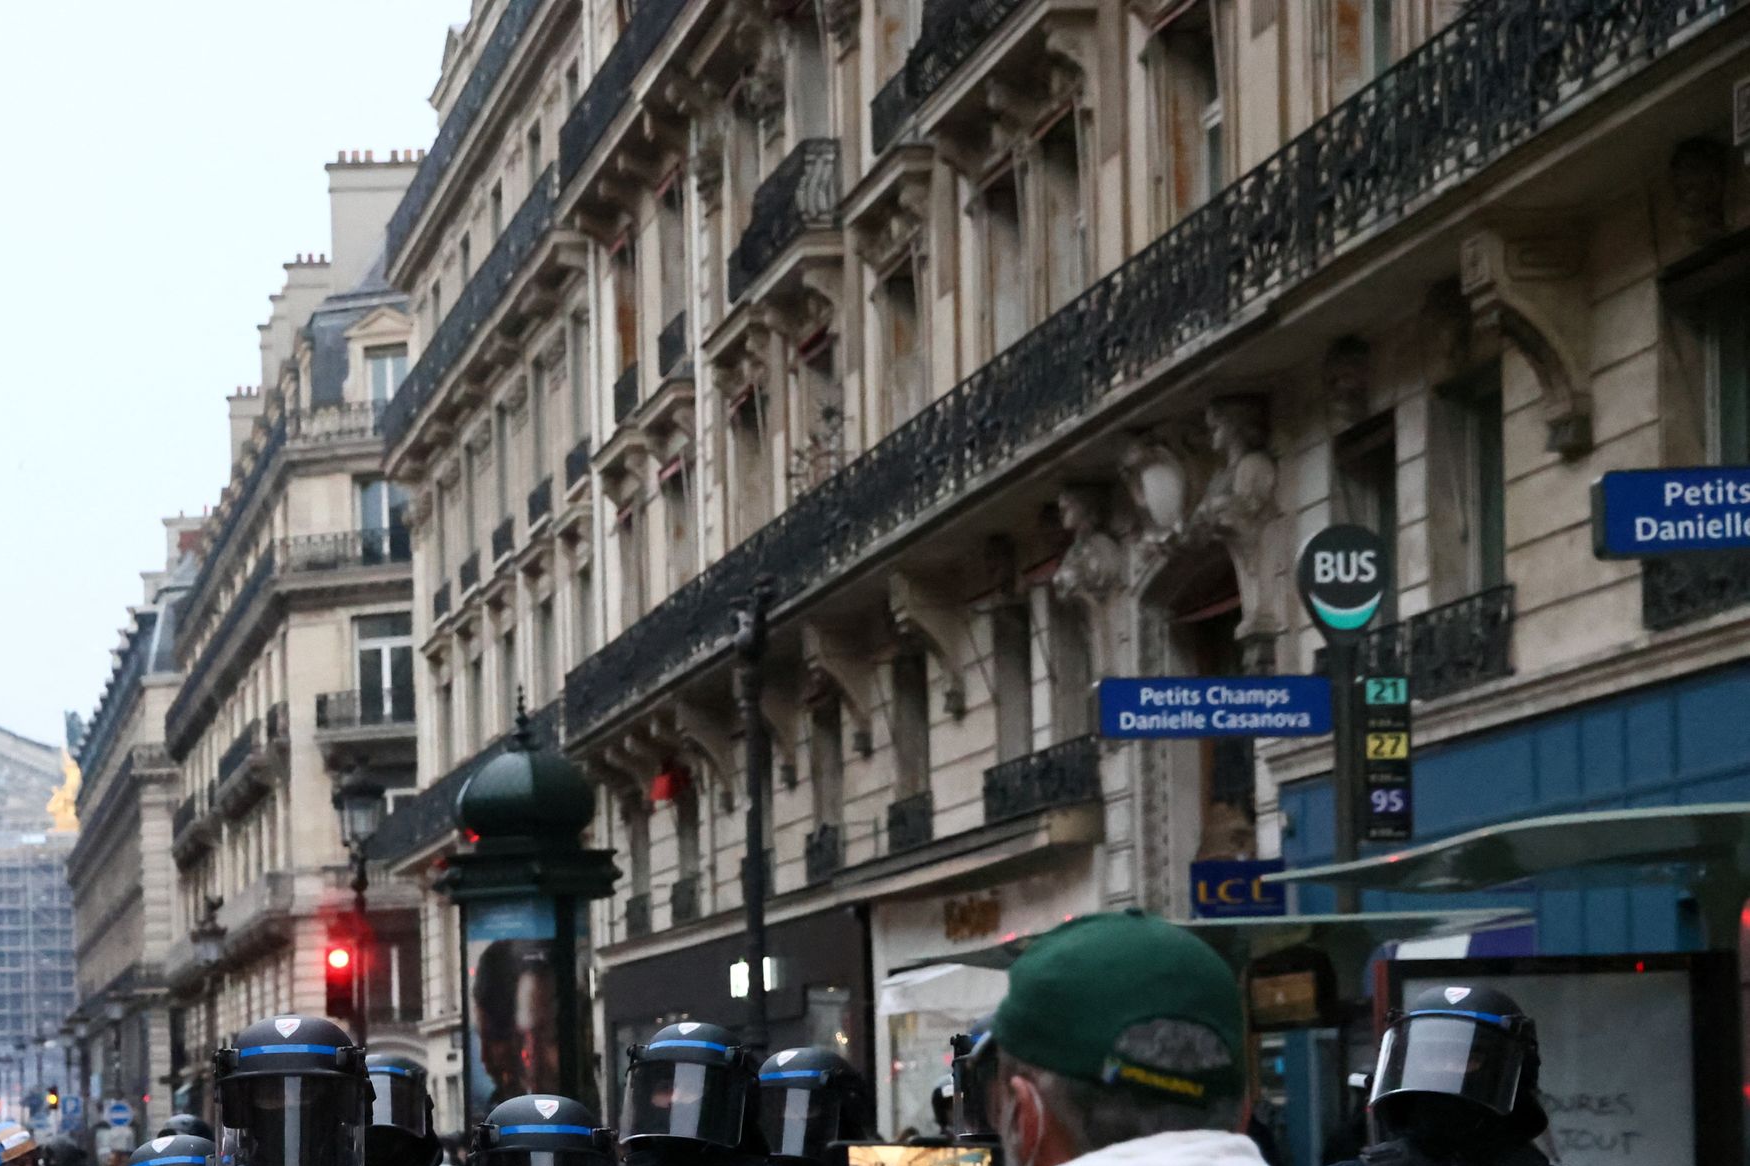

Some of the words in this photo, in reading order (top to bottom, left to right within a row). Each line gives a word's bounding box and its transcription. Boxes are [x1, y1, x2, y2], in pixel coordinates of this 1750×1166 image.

[1664, 479, 1750, 507] Petits
[1314, 550, 1377, 583] BUS
[1140, 686, 1200, 706] Petits
[1206, 685, 1290, 708] Champs
[1373, 680, 1401, 701] 21
[1119, 711, 1206, 730] Danielle
[1211, 709, 1310, 729] Casanova
[1371, 735, 1401, 757] 27
[1370, 788, 1404, 813] 95
